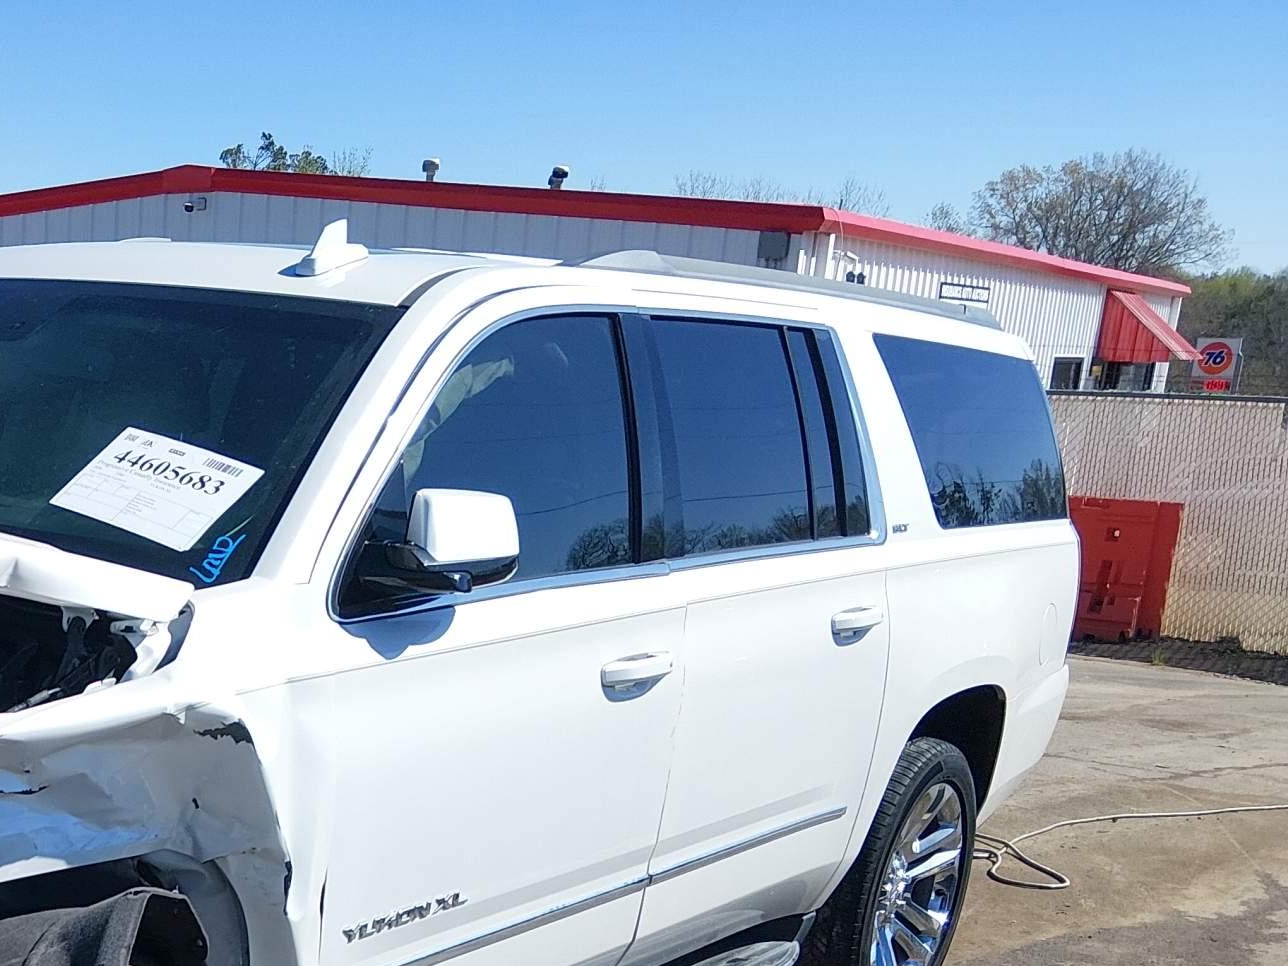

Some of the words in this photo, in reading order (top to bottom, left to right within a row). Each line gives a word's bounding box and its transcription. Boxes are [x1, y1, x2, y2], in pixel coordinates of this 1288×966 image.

[1202, 349, 1228, 366] 76
[113, 450, 225, 495] 44605683
[342, 903, 432, 944] YUKON
[432, 892, 468, 915] XL
